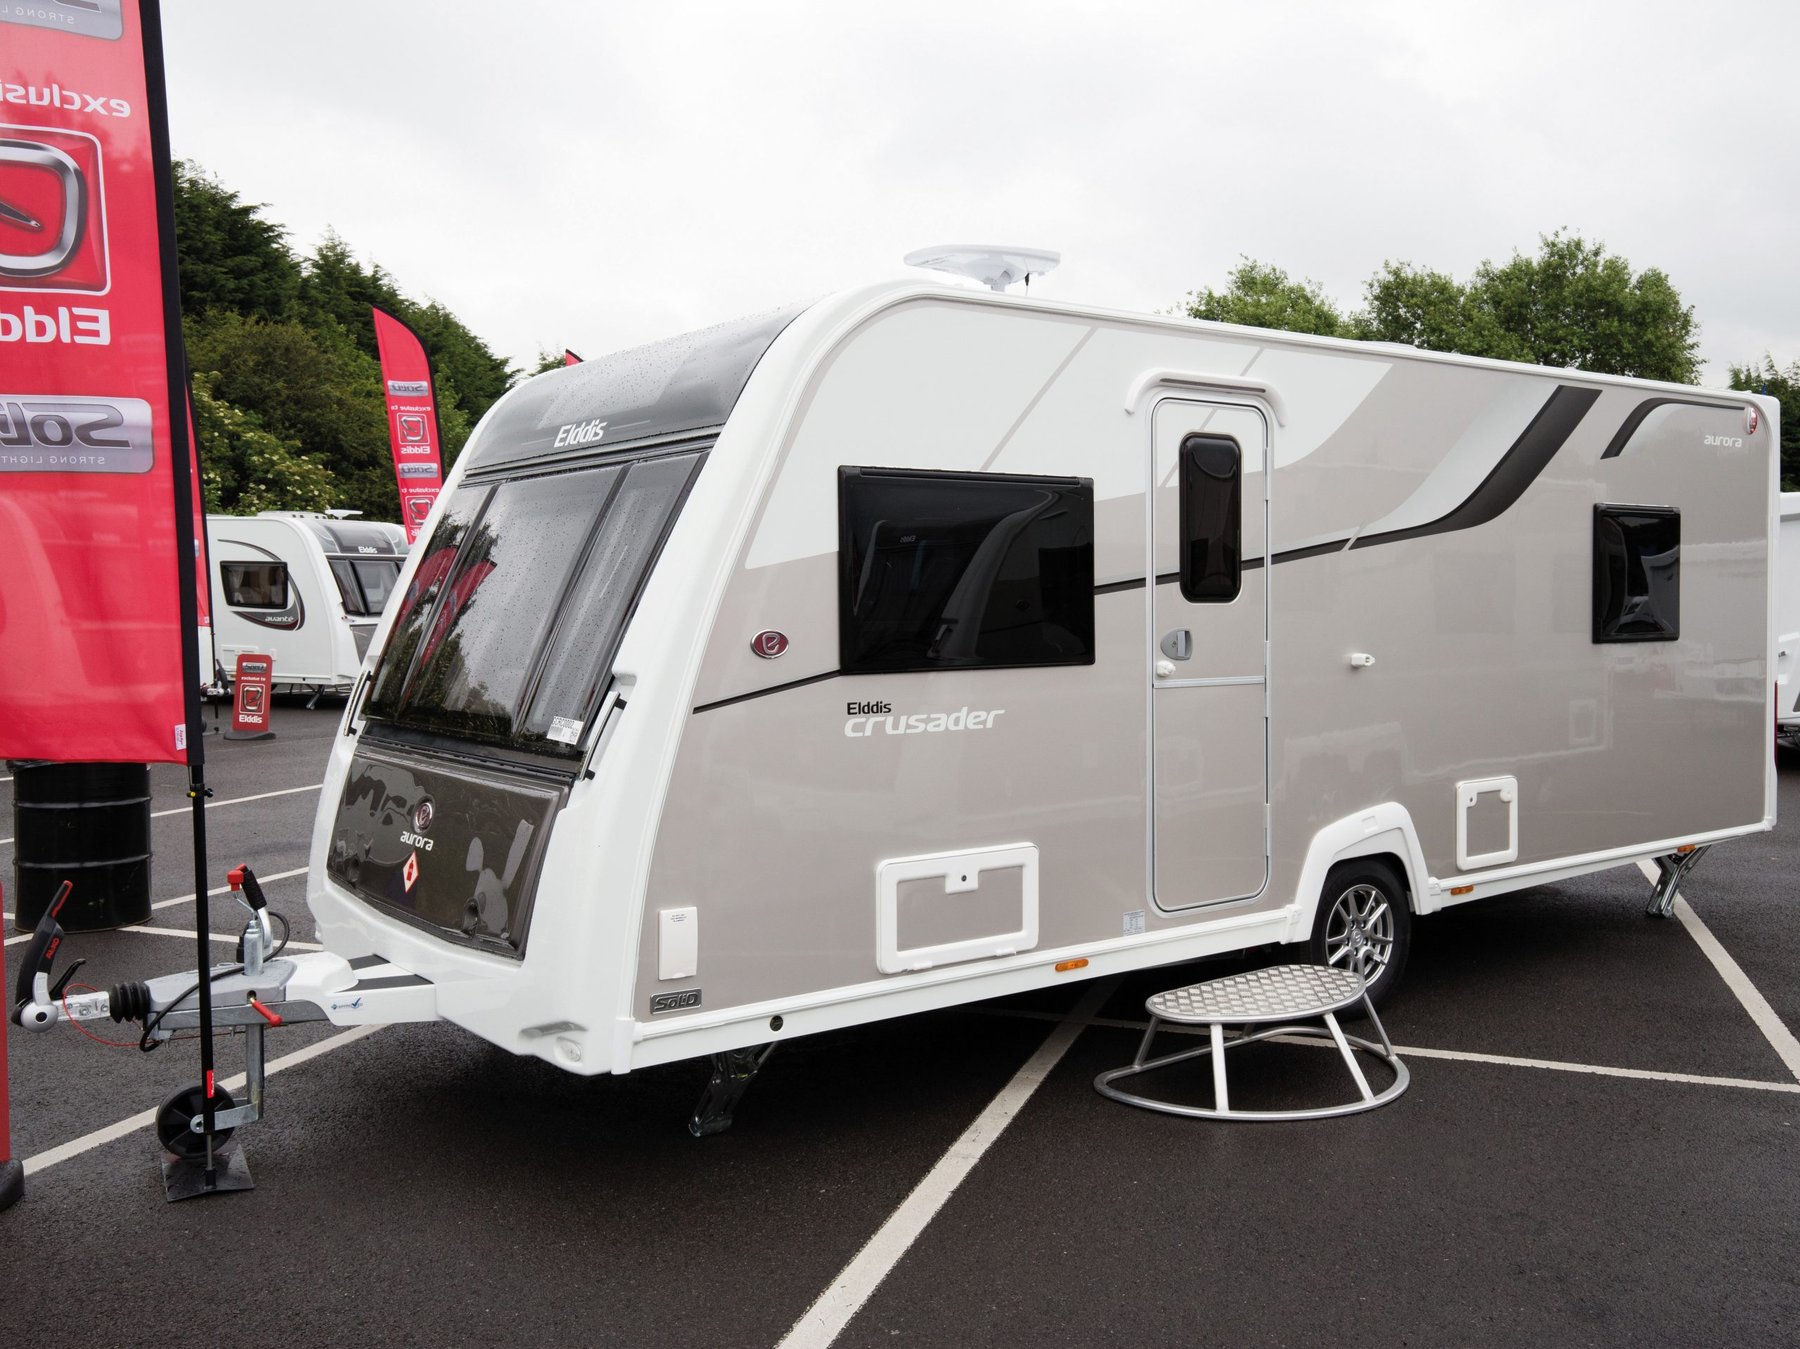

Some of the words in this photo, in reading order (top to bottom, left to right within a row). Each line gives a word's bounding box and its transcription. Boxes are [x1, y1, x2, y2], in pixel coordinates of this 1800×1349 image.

[553, 418, 608, 448] Elddis
[1703, 434, 1743, 447] aurora
[846, 701, 892, 715] Elddis
[239, 714, 263, 724] Elddis
[844, 706, 1005, 738] crusader
[400, 831, 434, 852] aurora
